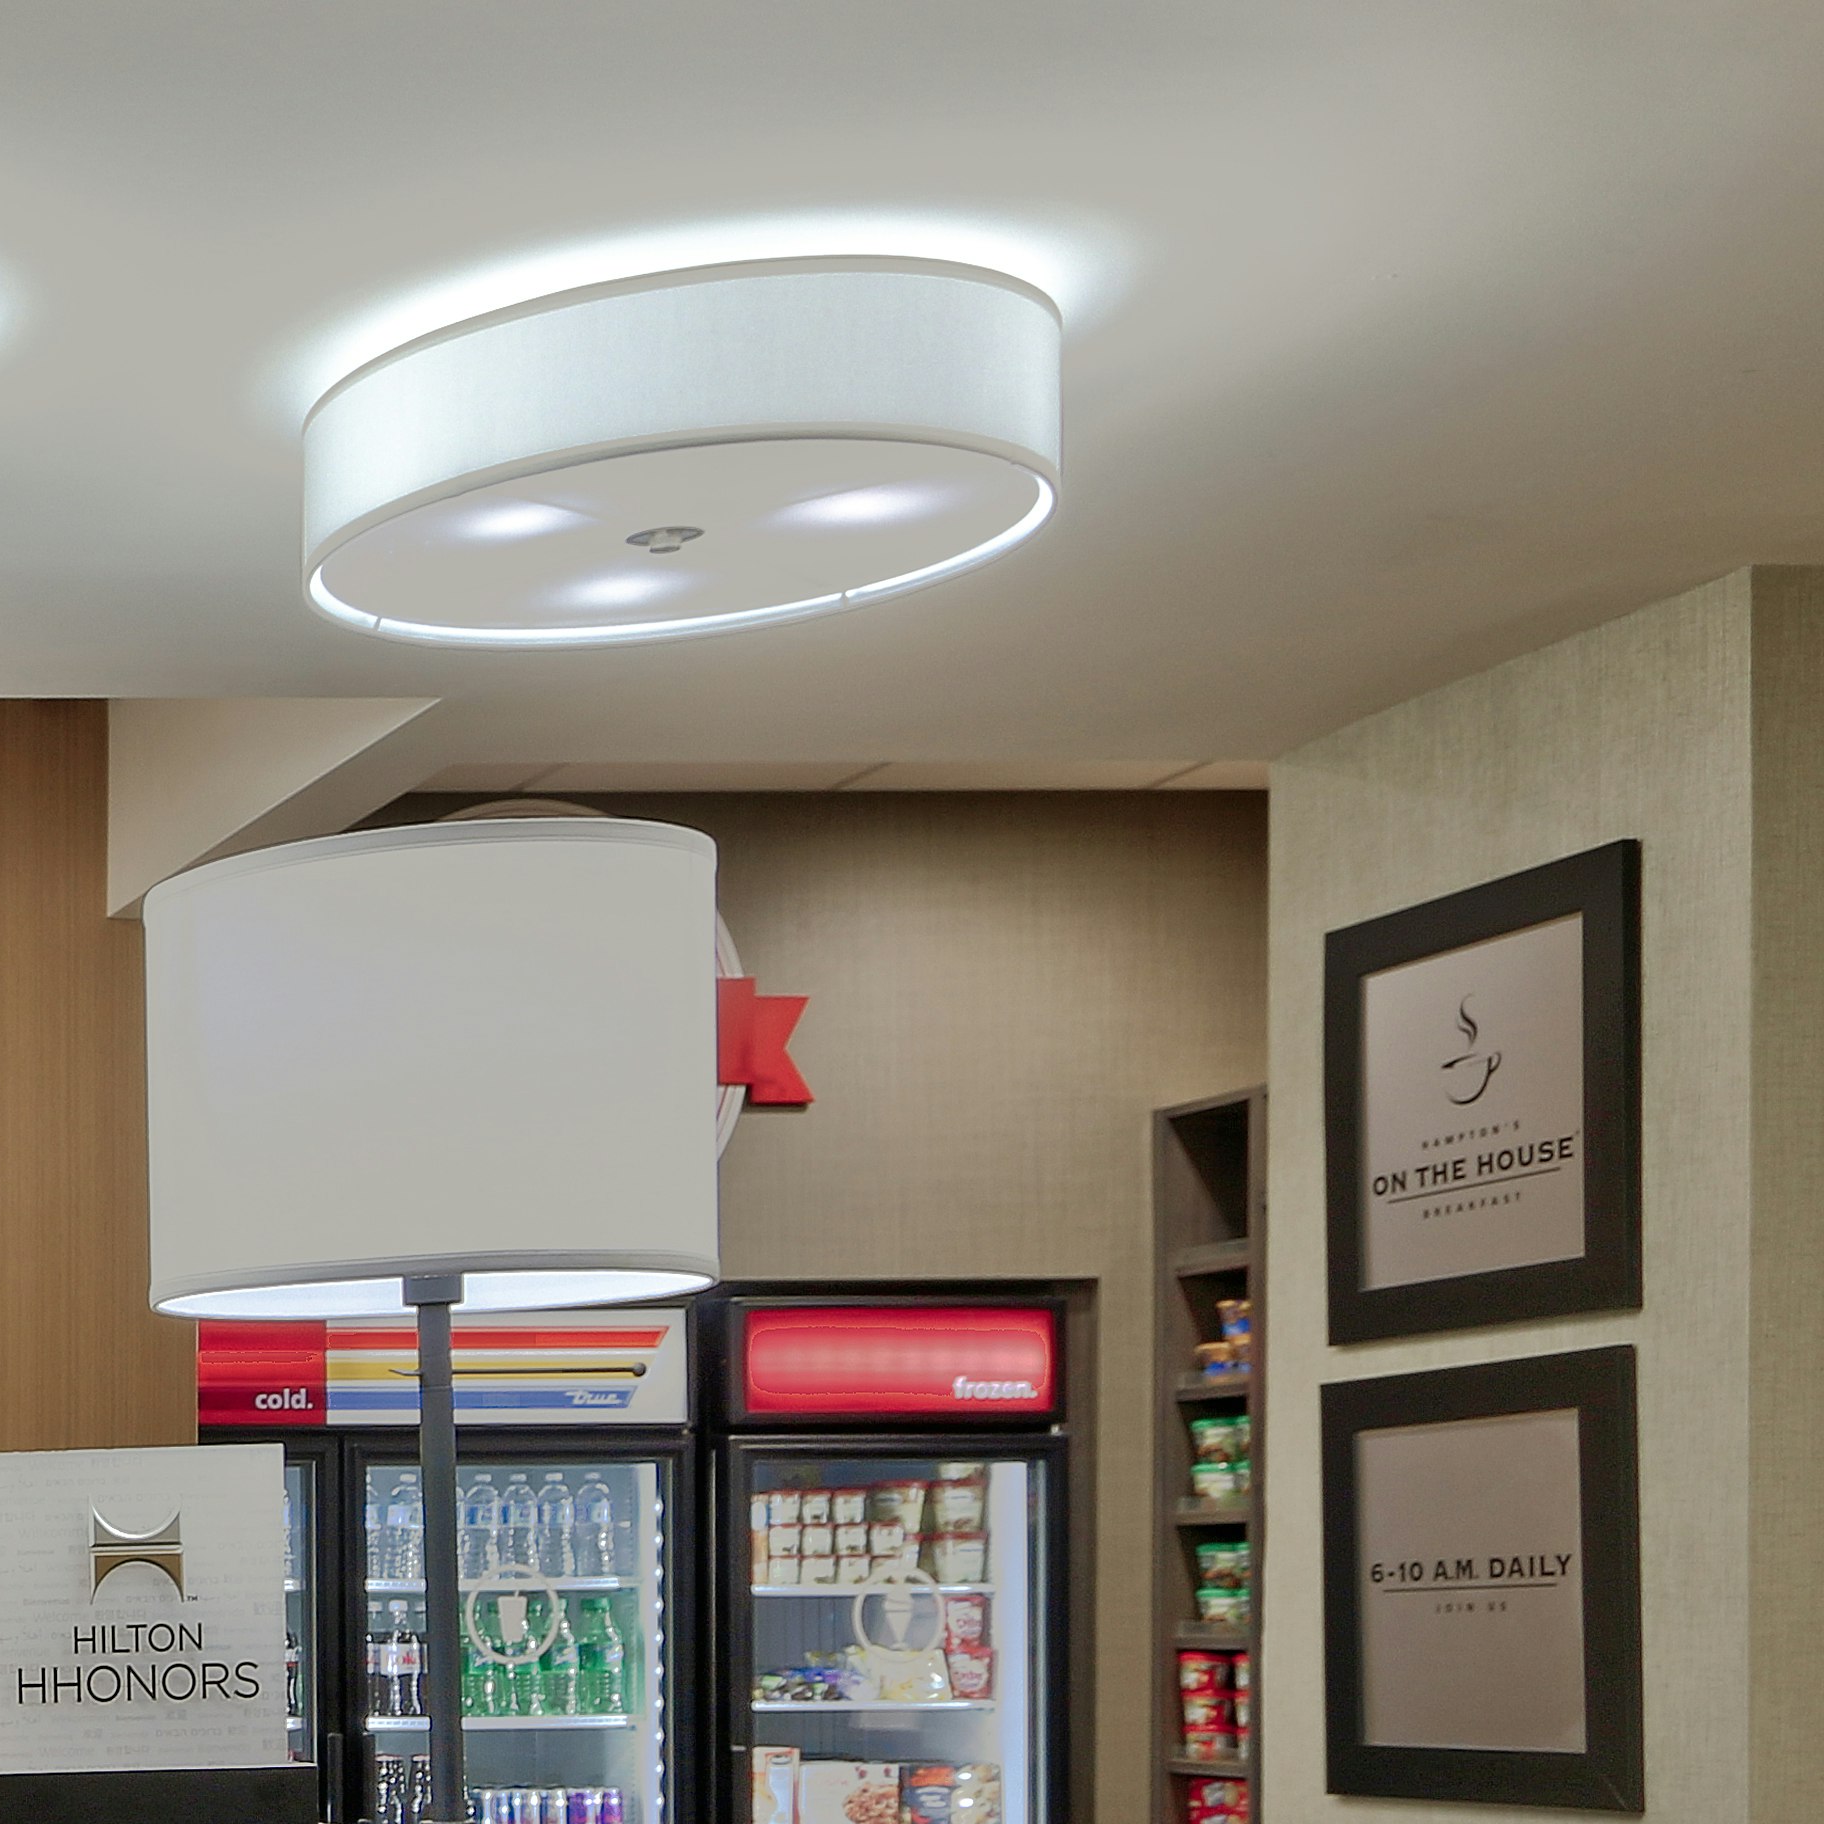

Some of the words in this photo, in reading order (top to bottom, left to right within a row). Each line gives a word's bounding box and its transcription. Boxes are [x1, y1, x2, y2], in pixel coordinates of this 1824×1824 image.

[1422, 1120, 1520, 1149] HAMPTON'S
[1373, 1171, 1407, 1196] ON
[1415, 1159, 1466, 1188] THE
[1477, 1137, 1574, 1176] HOUSE
[1423, 1192, 1521, 1219] BREAKFAST
[255, 1389, 313, 1409] cold.
[953, 1376, 1038, 1399] frozen.
[1371, 1562, 1424, 1583] 6-10
[1489, 1553, 1573, 1579] DAILY
[1436, 1602, 1474, 1614] JOIN
[1487, 1602, 1507, 1613] US
[73, 1622, 203, 1655] HILTON
[18, 1661, 260, 1704] HHONORS
